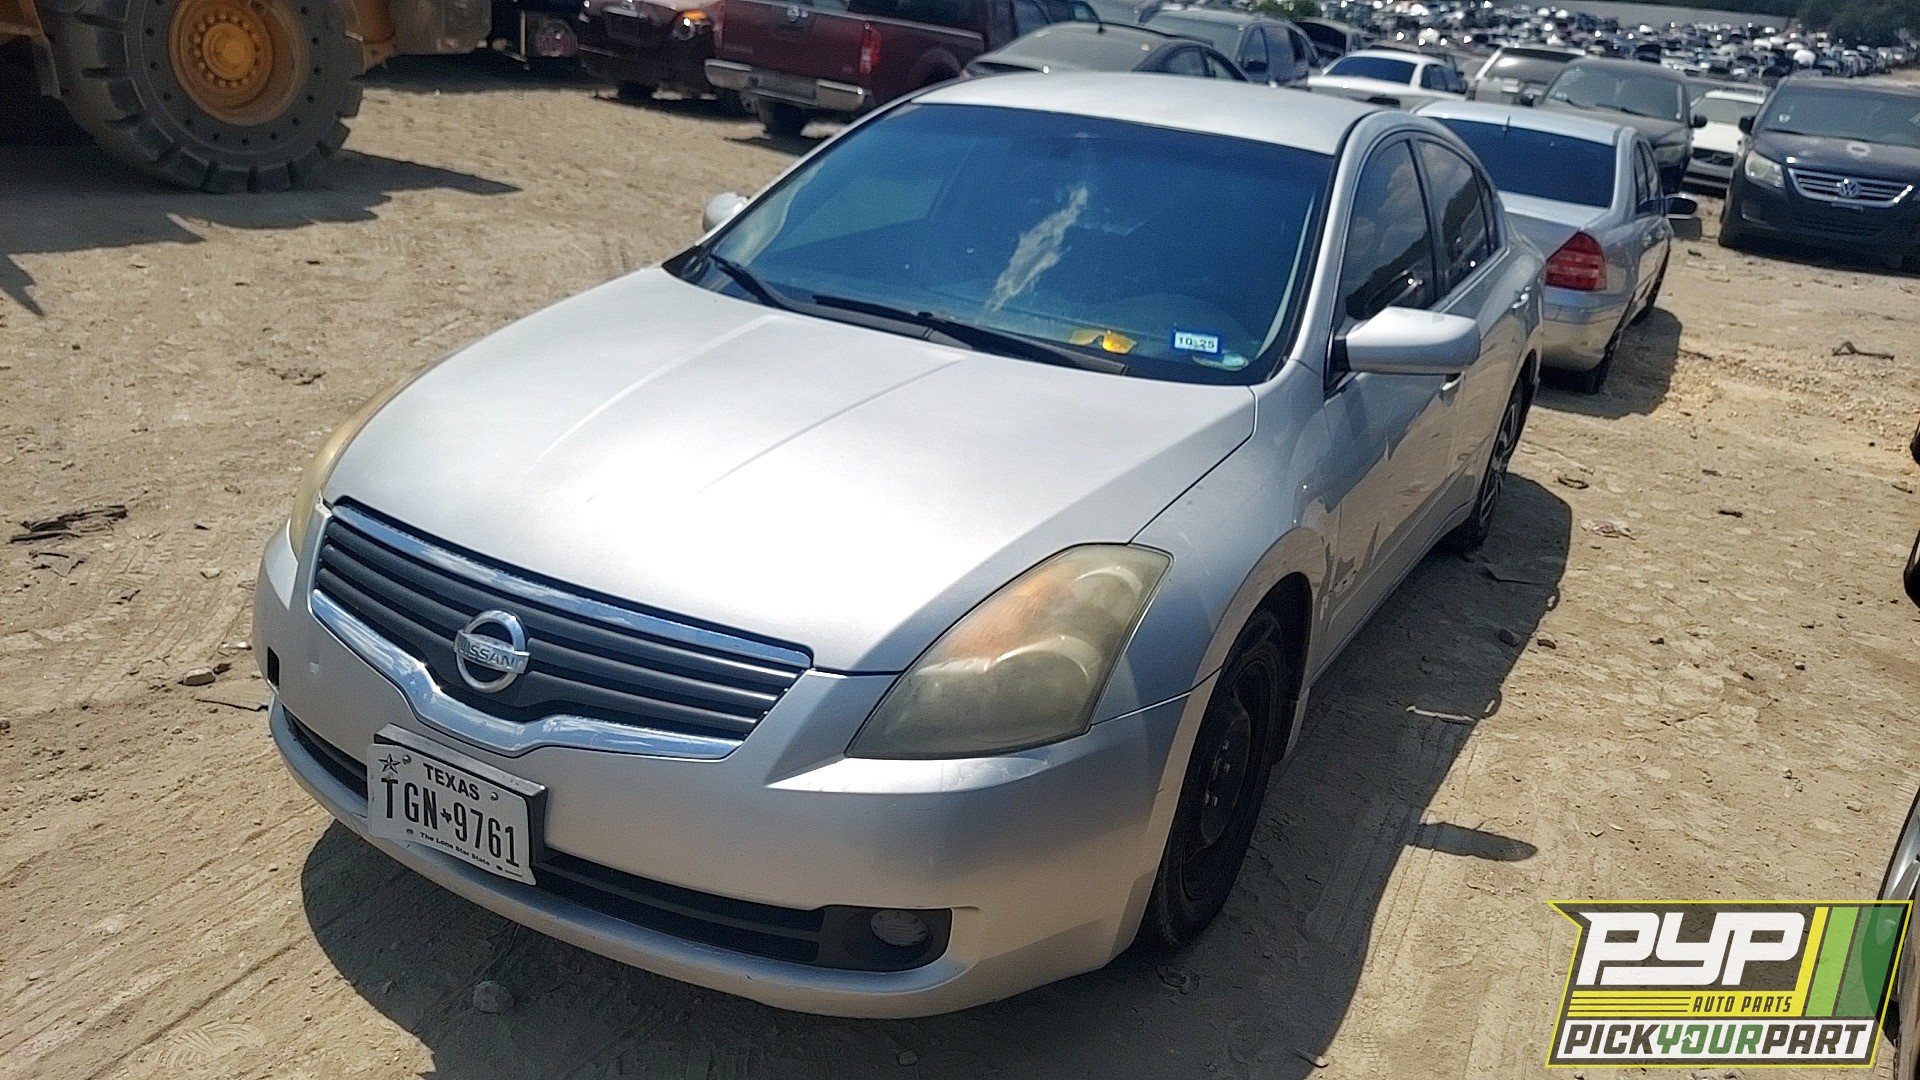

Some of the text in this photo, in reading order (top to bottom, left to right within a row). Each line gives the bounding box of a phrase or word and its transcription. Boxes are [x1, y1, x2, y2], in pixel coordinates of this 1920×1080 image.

[423, 763, 480, 801] TEXAS
[420, 831, 490, 866] The Lone Star State
